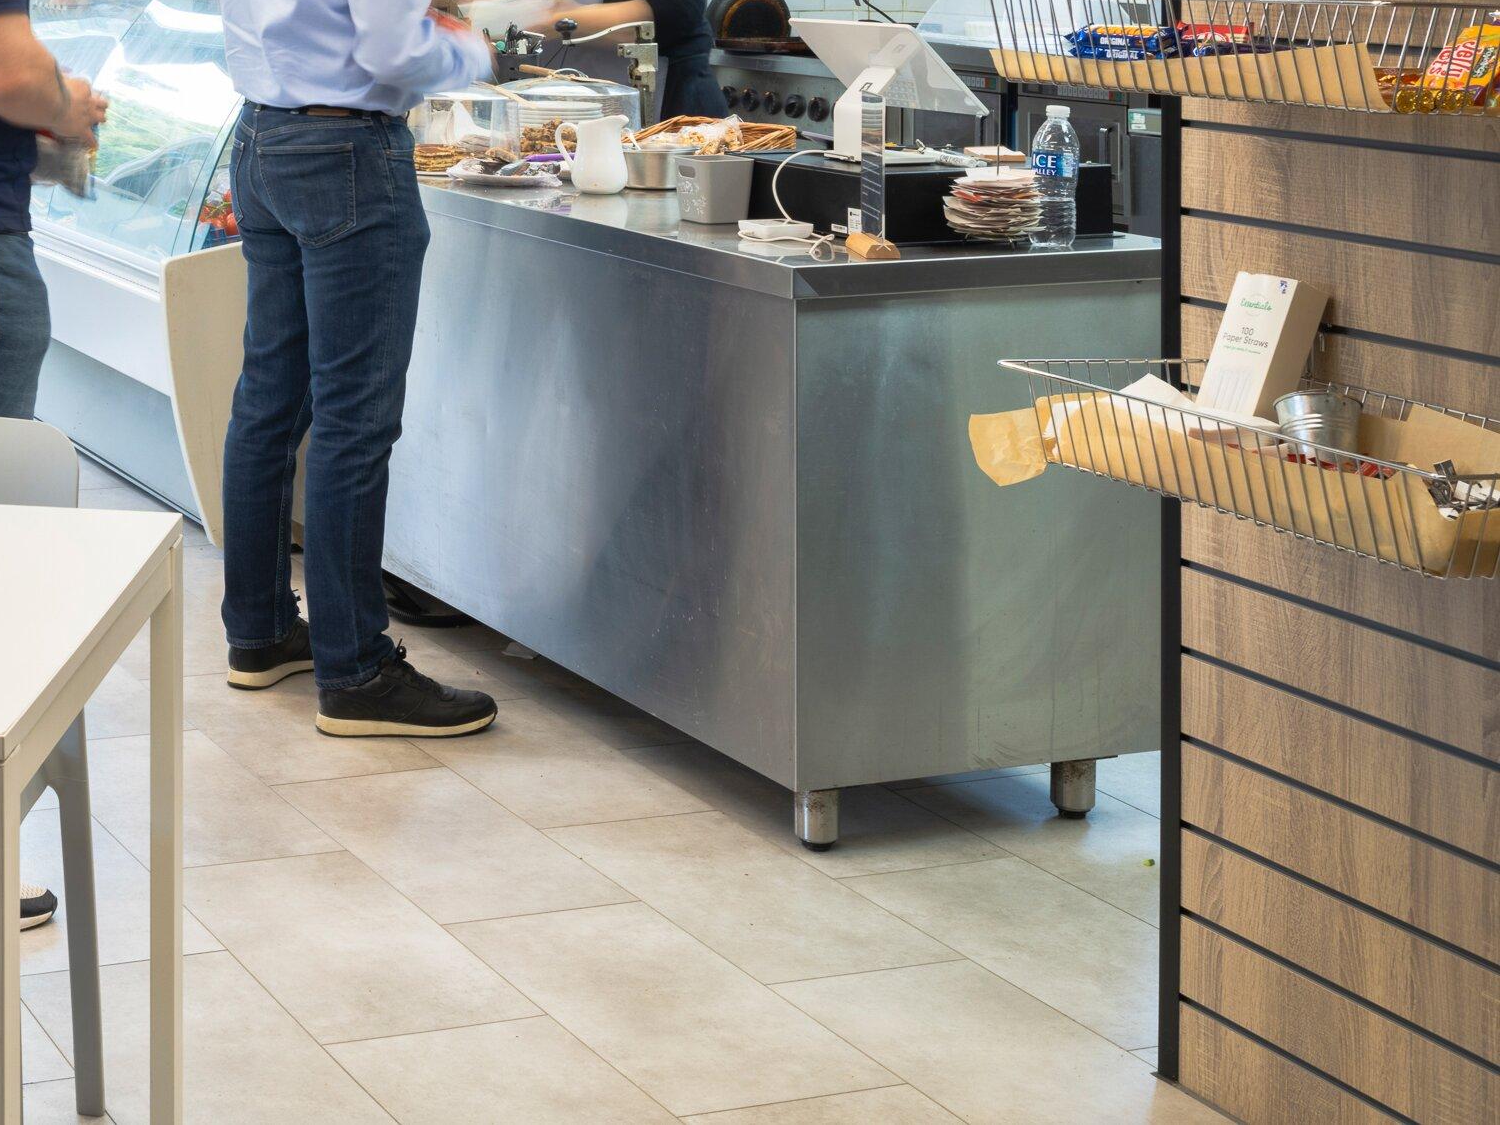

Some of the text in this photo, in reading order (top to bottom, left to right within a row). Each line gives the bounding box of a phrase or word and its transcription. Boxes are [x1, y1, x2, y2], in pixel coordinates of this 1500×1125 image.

[1100, 38, 1130, 46] ORIGINAL
[1032, 154, 1057, 168] ICE
[1240, 298, 1272, 311] Essentials
[1242, 327, 1254, 336] 100
[1223, 333, 1268, 348] Paper Straws
